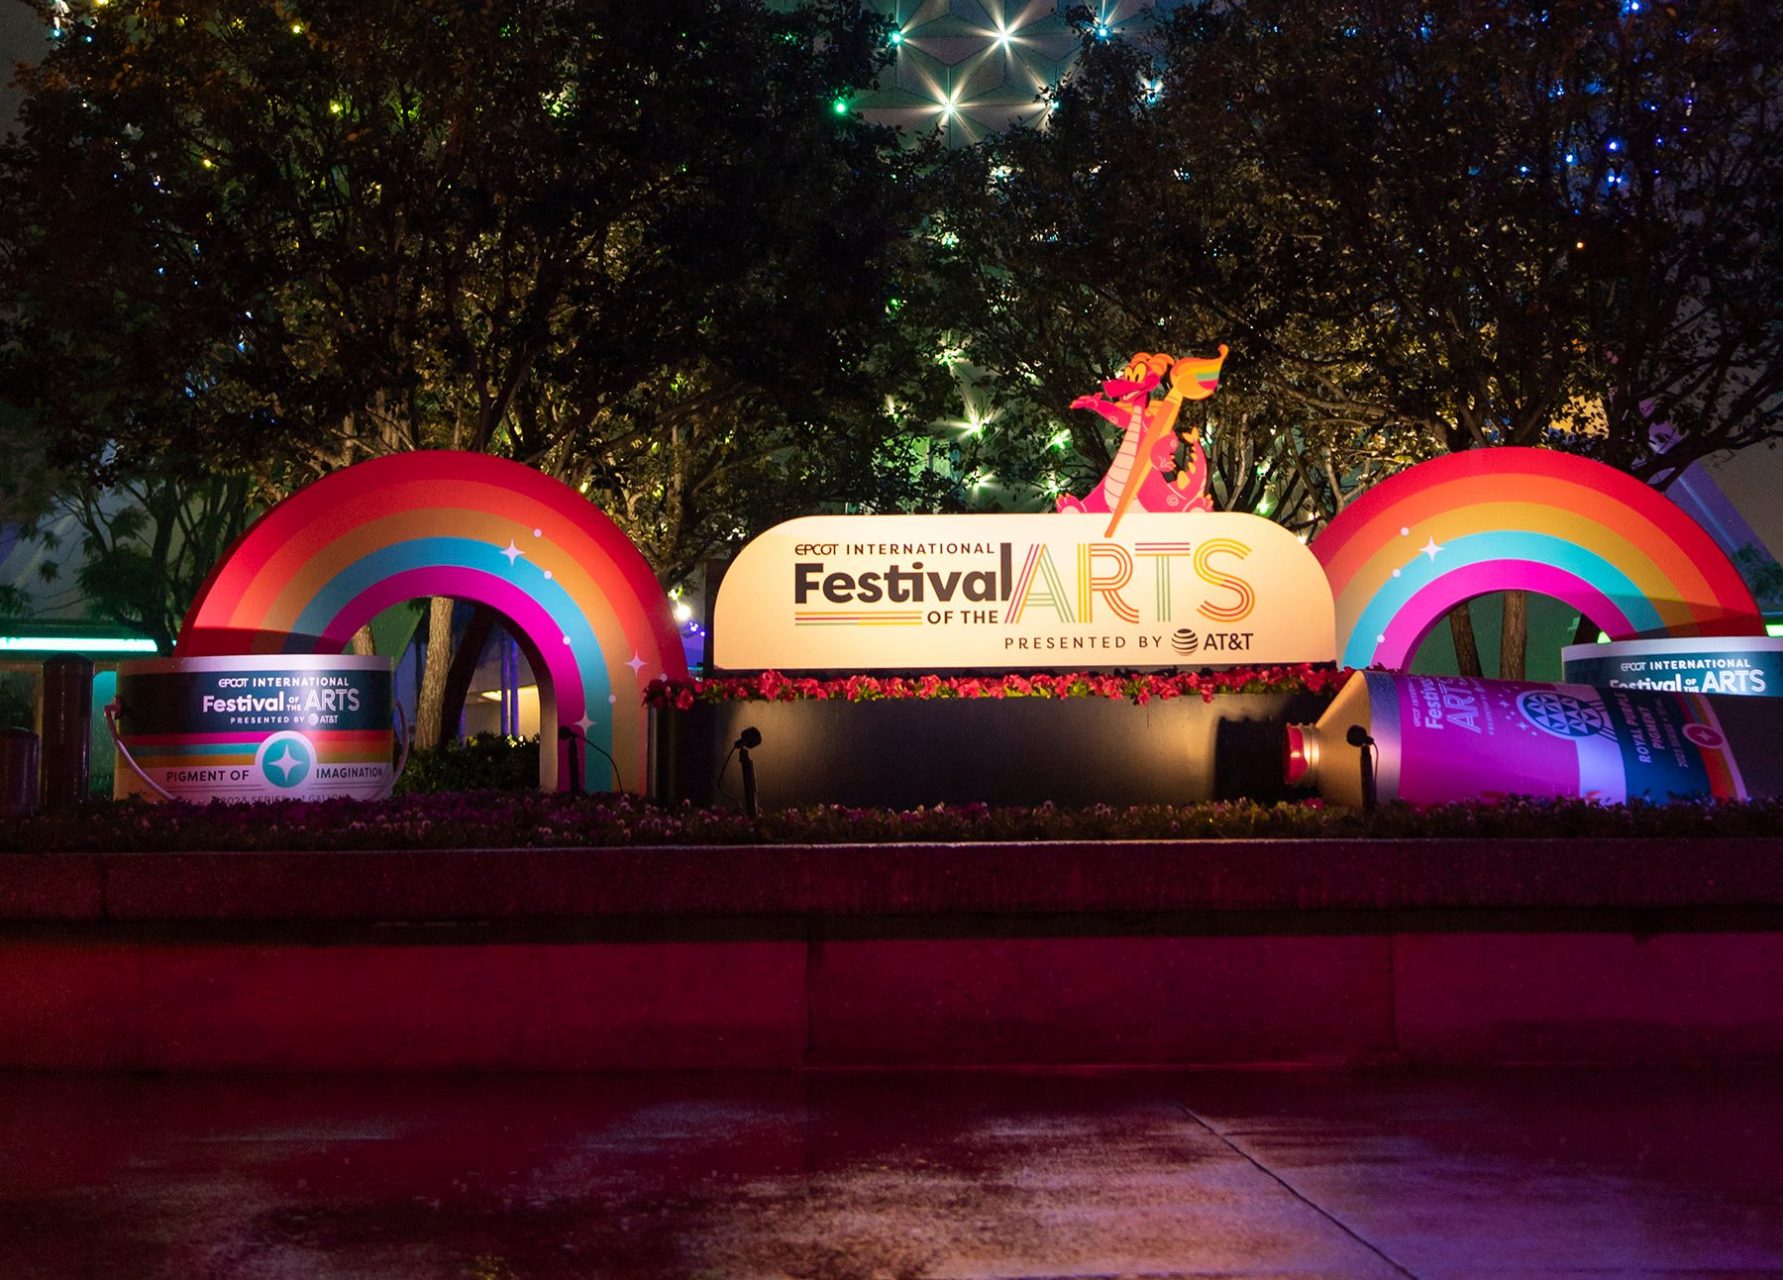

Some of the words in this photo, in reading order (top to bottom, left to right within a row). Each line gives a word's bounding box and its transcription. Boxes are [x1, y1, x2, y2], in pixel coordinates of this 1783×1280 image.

[795, 543, 839, 556] EPCOT
[846, 542, 995, 555] INTERNATIONAL
[794, 542, 1012, 604] Festival
[1004, 538, 1256, 624] ARTS
[927, 610, 954, 625] OF
[960, 609, 999, 624] THE
[1004, 636, 1127, 650] PRESENTED
[1138, 635, 1163, 649] BY
[1203, 632, 1254, 651] AT&T
[1620, 662, 1647, 672] EPCOT
[1649, 658, 1752, 671] INTERNATIONAL
[218, 677, 249, 689] EPCOT
[252, 676, 350, 688] INTERNATIONAL
[1684, 678, 1697, 686] OF
[1700, 669, 1767, 694] ARTS
[202, 690, 285, 713] Festival
[288, 696, 300, 704] OF
[304, 687, 361, 712] ARTS
[286, 704, 302, 712] THE
[230, 716, 290, 725] PRESENTED
[293, 716, 305, 724] BY
[319, 714, 339, 724] AT&T
[1637, 705, 1666, 750] PIGMENT
[1629, 727, 1653, 764] ROYAL
[165, 770, 226, 783] PIGMENT
[230, 770, 250, 781] OF
[316, 767, 384, 780] IMAGINATION
